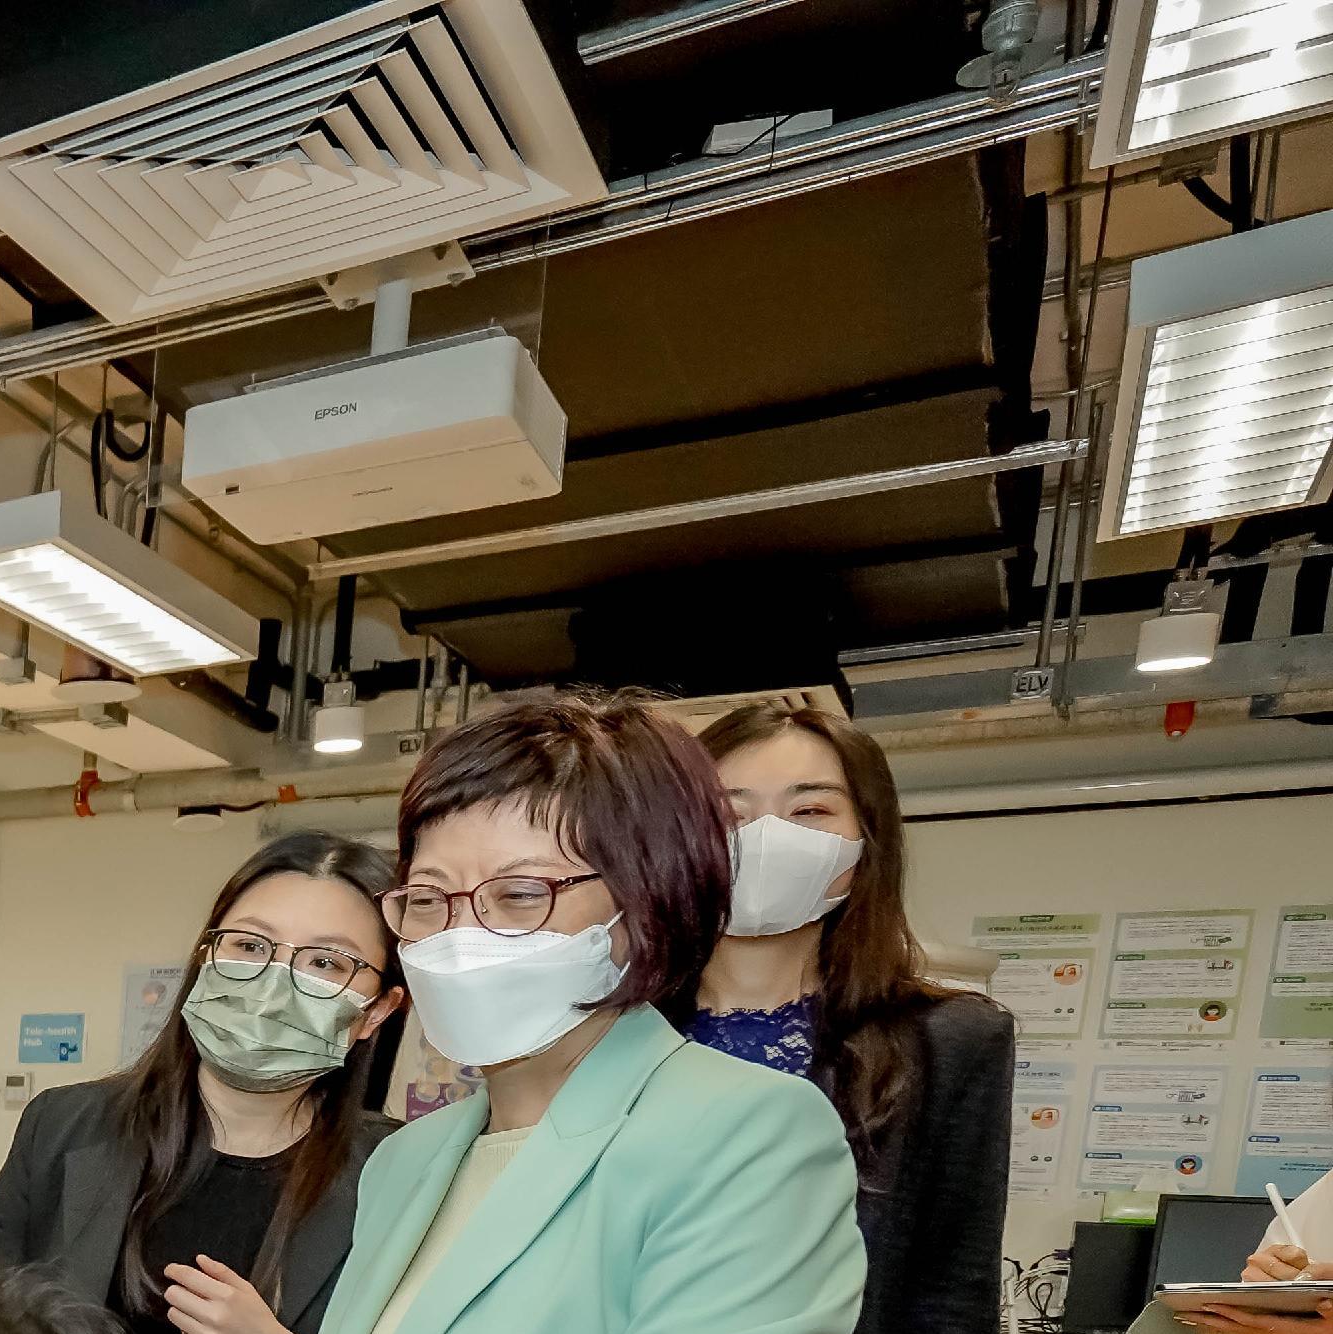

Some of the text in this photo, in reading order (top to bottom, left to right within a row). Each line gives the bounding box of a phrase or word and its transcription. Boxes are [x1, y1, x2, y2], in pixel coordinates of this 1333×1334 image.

[314, 402, 357, 421] EPSON
[1016, 675, 1049, 692] ELV
[399, 739, 422, 753] ELV
